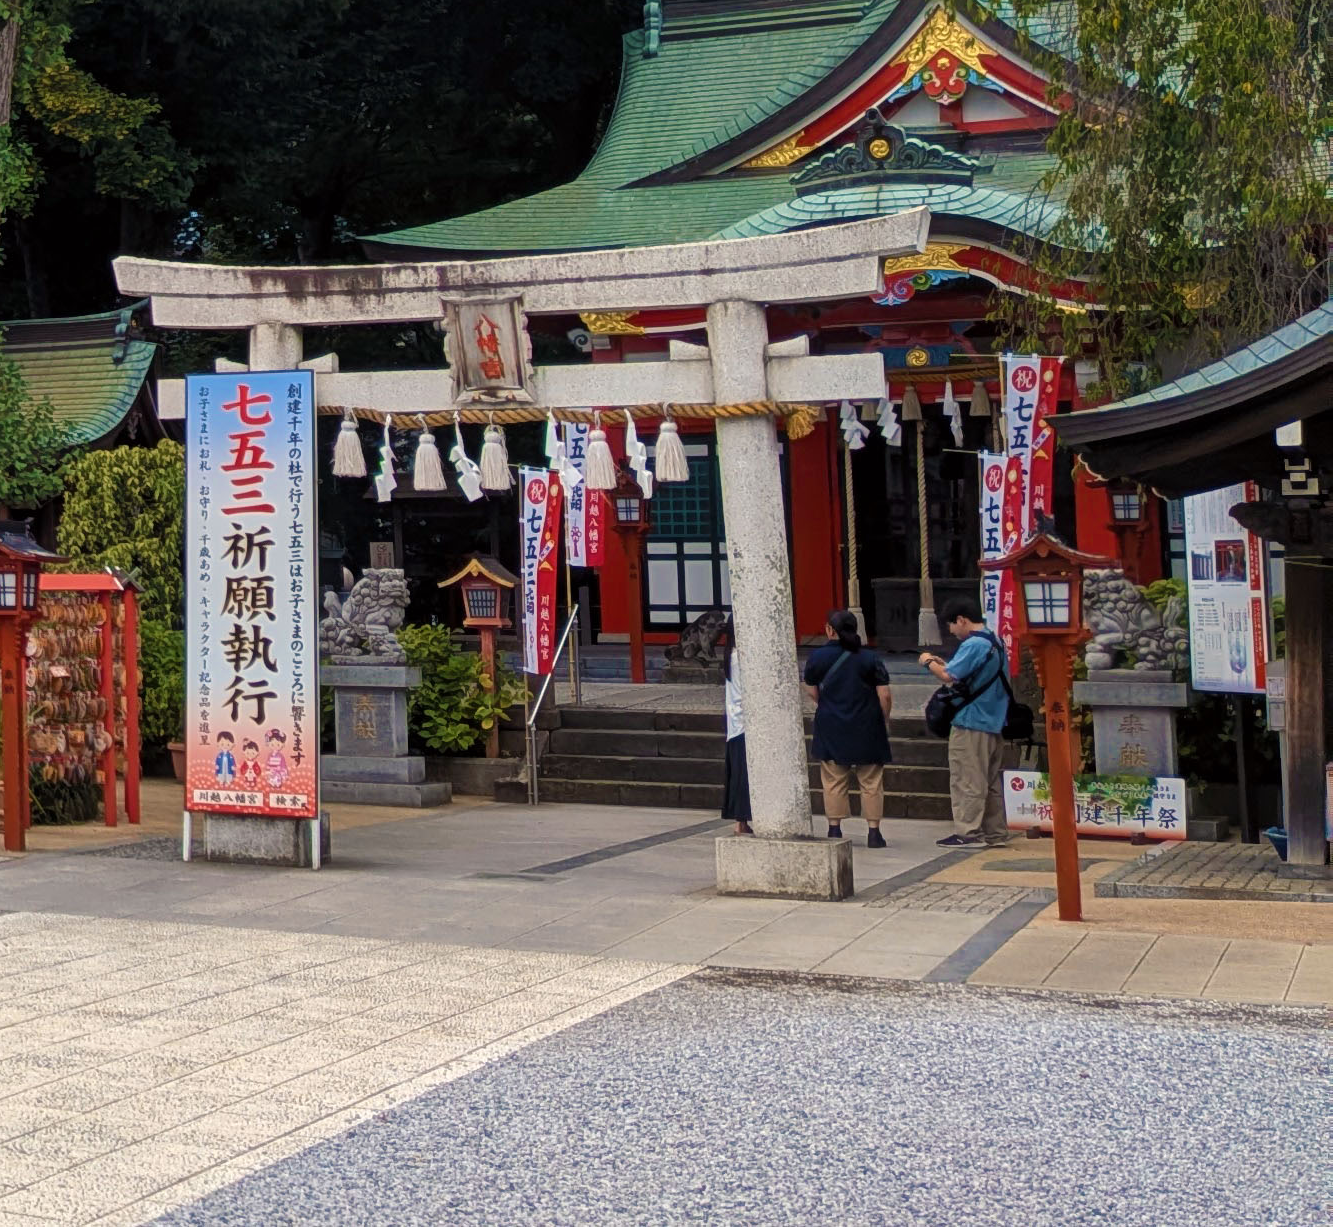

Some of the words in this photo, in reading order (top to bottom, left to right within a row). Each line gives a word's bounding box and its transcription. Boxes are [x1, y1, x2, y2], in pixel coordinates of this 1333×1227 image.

[1015, 369, 1033, 389] 祝
[530, 483, 544, 502] 祝
[988, 468, 1001, 488] 祝
[588, 492, 600, 554] 川越八幡宮
[220, 384, 279, 726] 七五三祈願執行
[286, 383, 306, 767] 創建千年の杜で行う七五三はお子さまのこころに響きます
[539, 594, 550, 661] 川越八幡宮
[198, 792, 259, 805] 川越八幡宮
[275, 795, 302, 807] 検索
[1036, 801, 1053, 822] 祝
[1075, 803, 1178, 830] 建千年祭
